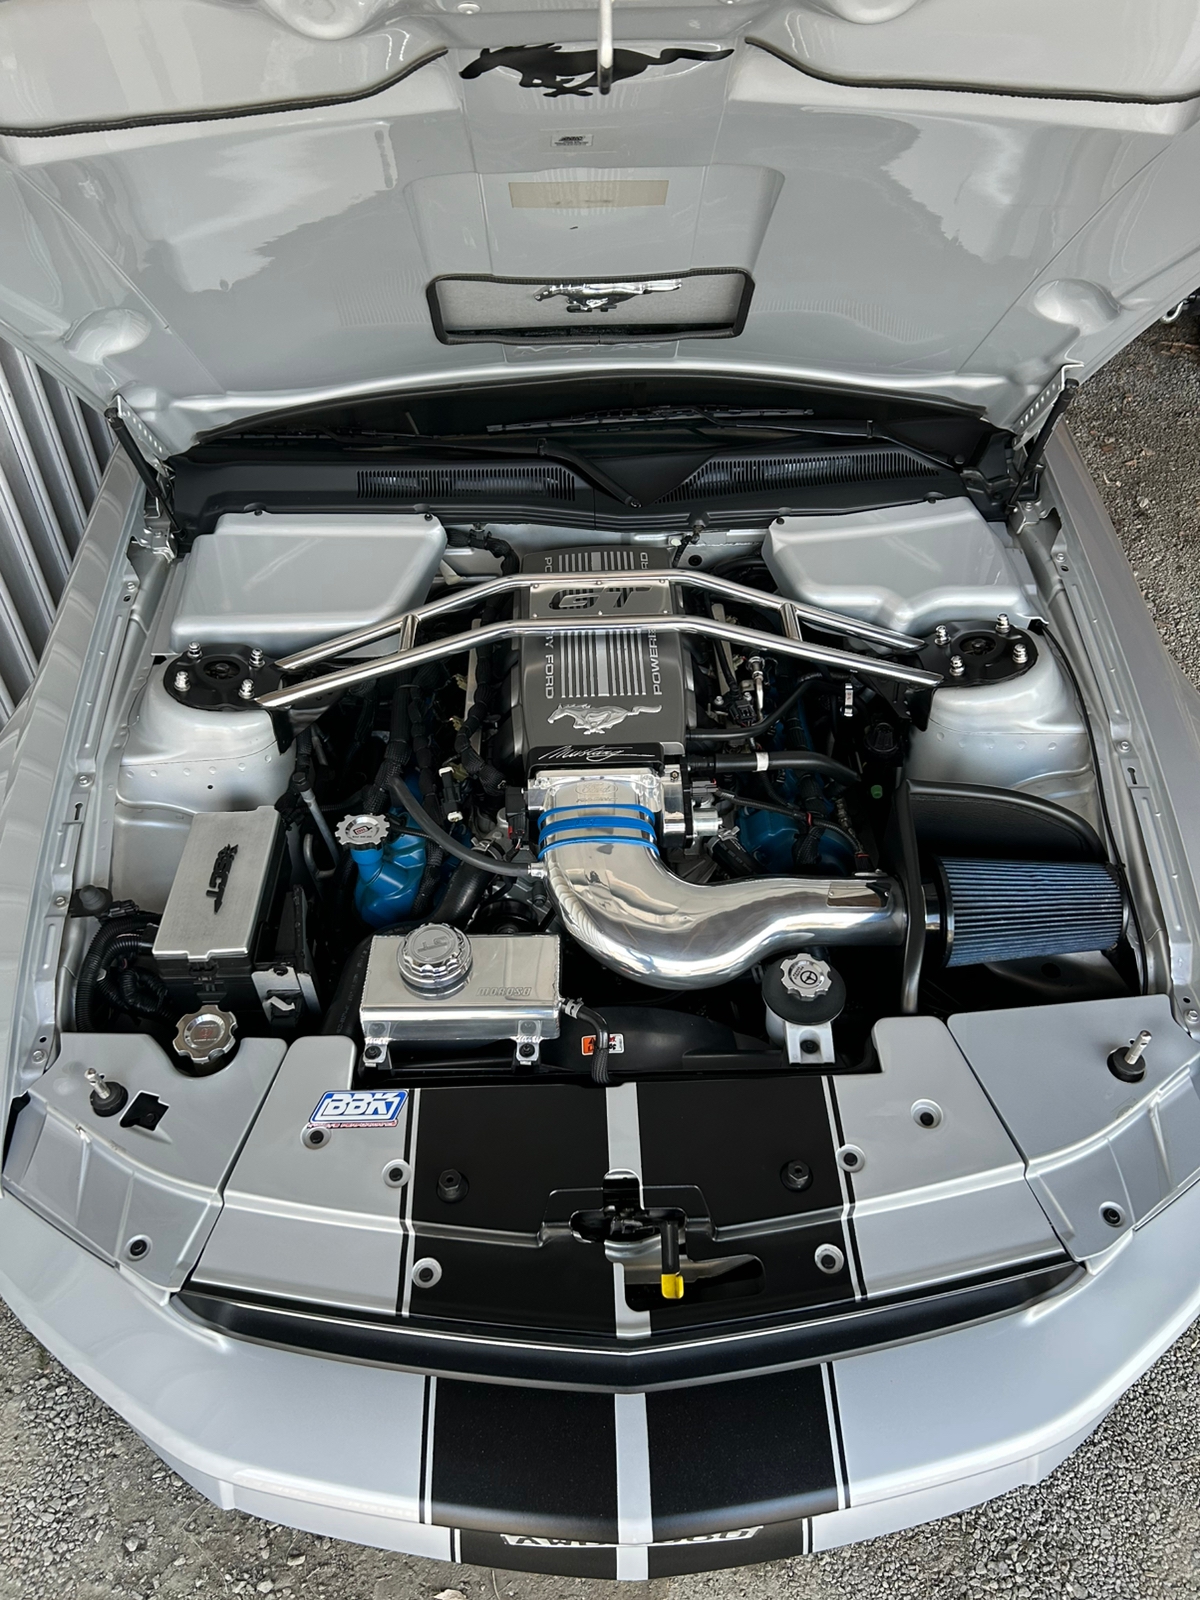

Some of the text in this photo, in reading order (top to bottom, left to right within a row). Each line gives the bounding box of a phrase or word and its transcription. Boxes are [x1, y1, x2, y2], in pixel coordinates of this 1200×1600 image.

[548, 585, 653, 610] GT
[648, 629, 662, 696] POWERE
[545, 654, 554, 699] FORD
[538, 744, 656, 762] Mustang
[476, 986, 533, 997] MOROSO
[321, 1092, 400, 1116] BBK
